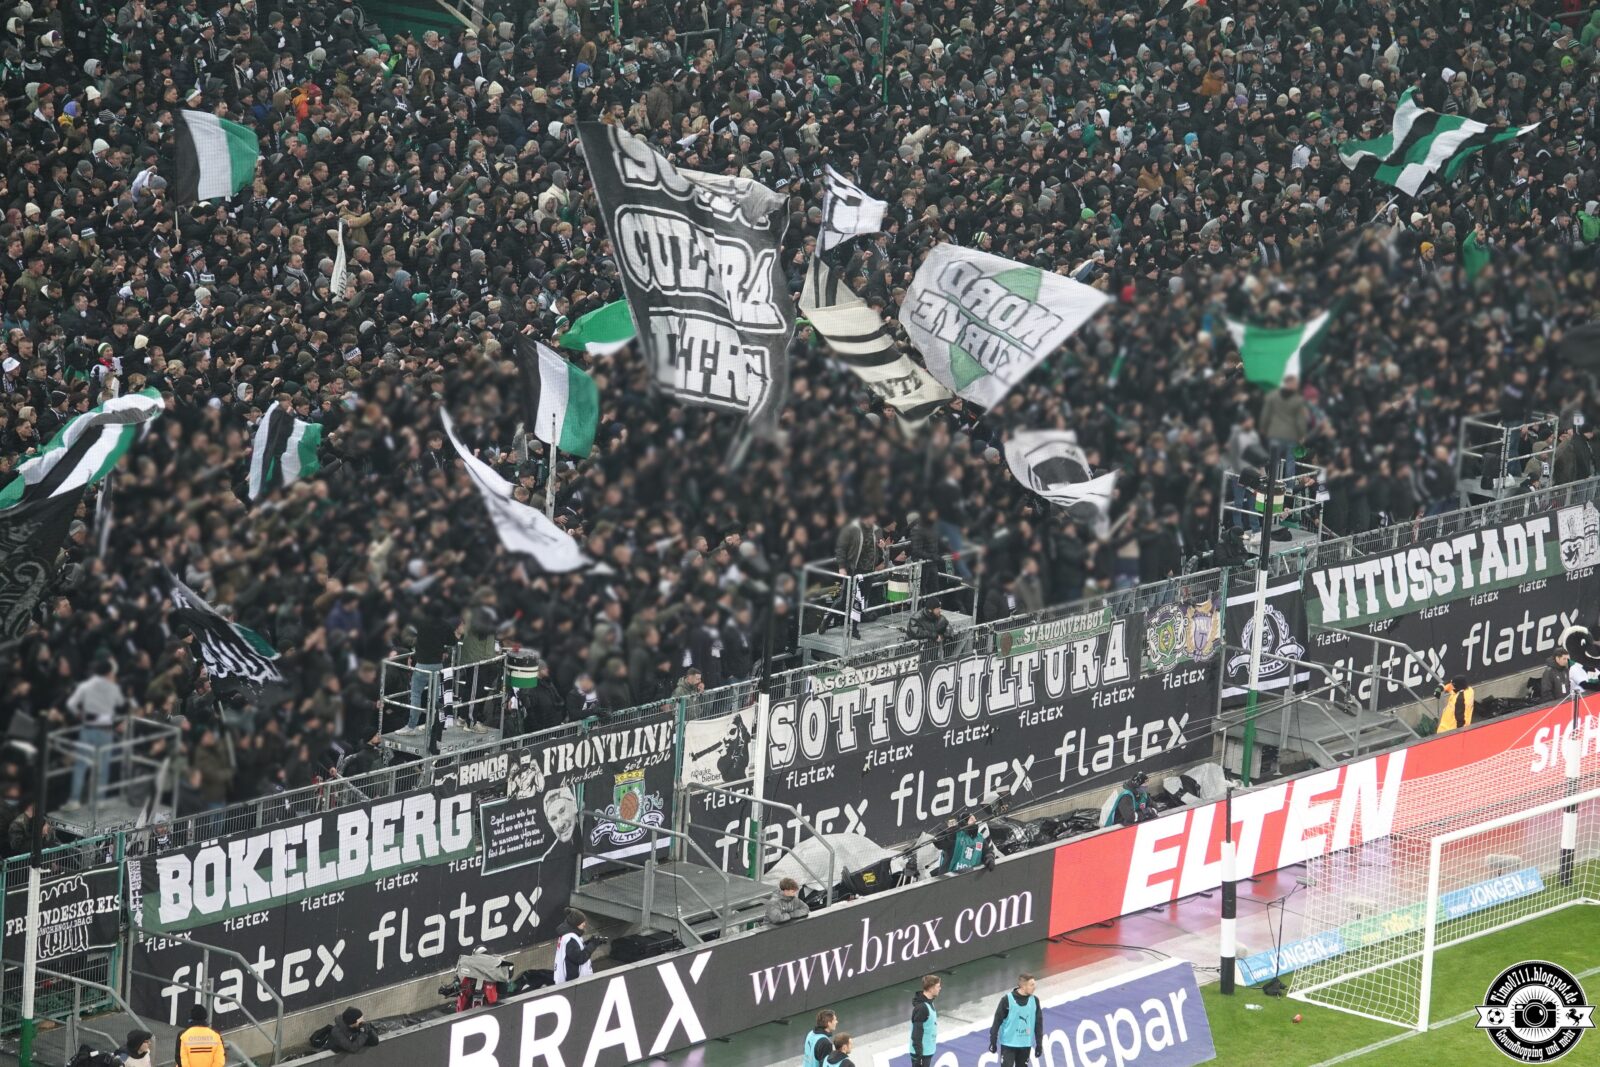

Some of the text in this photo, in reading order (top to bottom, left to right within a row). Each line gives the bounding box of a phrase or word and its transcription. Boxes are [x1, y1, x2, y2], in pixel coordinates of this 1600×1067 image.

[616, 205, 786, 333] CULRA
[1312, 517, 1551, 624] VITUSSTADT
[1518, 578, 1547, 594] flatex
[1419, 604, 1450, 620] flatex
[1469, 591, 1499, 607] flatex
[1369, 618, 1394, 634] flat
[1462, 608, 1579, 671] flatex
[811, 654, 920, 694] ASCENDENTE
[1162, 668, 1206, 691] flatex
[768, 619, 1131, 770] SOTTOCULTURA
[1091, 686, 1135, 709] flatex
[943, 723, 990, 747] flatex
[1018, 705, 1064, 728] flatex
[542, 721, 674, 777] FRONTLINE
[865, 744, 914, 766] flatex
[1055, 713, 1190, 782] flatex
[460, 754, 508, 786] BANDA
[786, 764, 835, 790] flatex
[891, 754, 1035, 828] flatex
[1120, 747, 1408, 914] ELTEN
[156, 792, 473, 926] BÖKELBERG
[448, 855, 482, 875] flate
[301, 890, 346, 912] flatex
[375, 872, 418, 893] flatex
[6, 894, 120, 937] FRNDESKREIS
[223, 911, 270, 933] flatex
[369, 887, 543, 970] flatex
[749, 890, 1034, 1005] www.brax.com
[161, 938, 347, 1026] flatex
[448, 951, 712, 1067] BRAX
[978, 988, 1189, 1067] nepar
